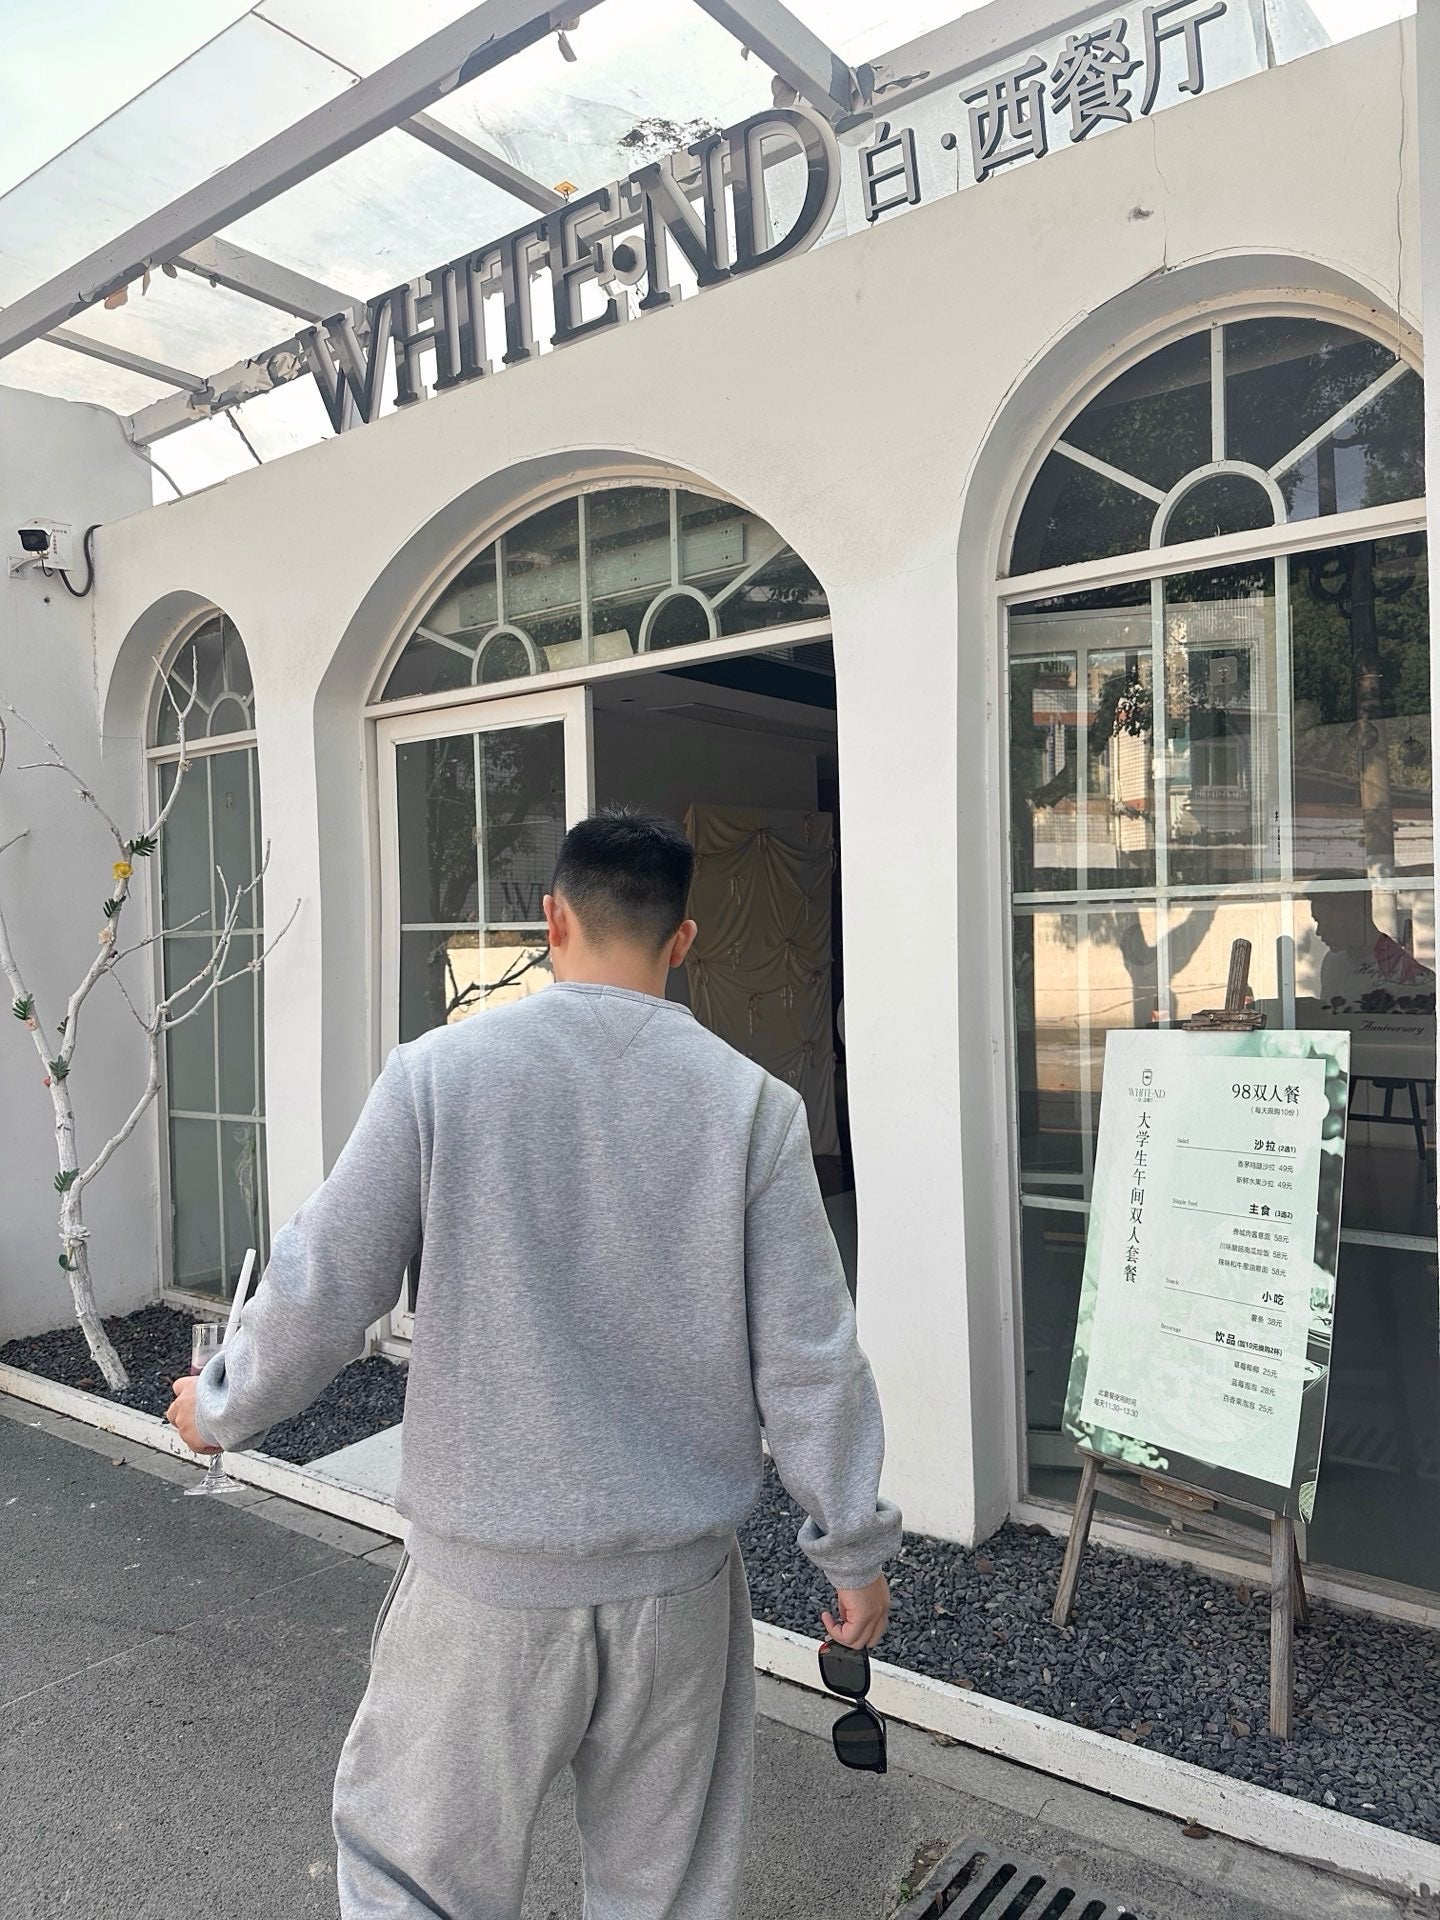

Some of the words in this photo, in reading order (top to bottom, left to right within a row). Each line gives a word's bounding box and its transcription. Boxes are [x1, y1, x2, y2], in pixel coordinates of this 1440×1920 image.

[1360, 1020, 1425, 1035] Anniversary
[1231, 1083, 1300, 1104] 98双人餐
[1254, 1139, 1276, 1152] 沙拉
[1278, 1164, 1294, 1174] 49元
[1277, 1180, 1293, 1190] 49元
[1123, 1111, 1151, 1283] 大学生午间双人套餐
[1249, 1203, 1271, 1217] 主食
[1273, 1233, 1290, 1244] 58元
[1272, 1249, 1289, 1261] 58元
[1271, 1266, 1288, 1278] 58元
[1261, 1291, 1285, 1306] 小吃
[1267, 1317, 1283, 1328] 38元
[1215, 1331, 1236, 1347] 饮品
[1262, 1367, 1279, 1379] 25元
[1258, 1403, 1275, 1415] 25元
